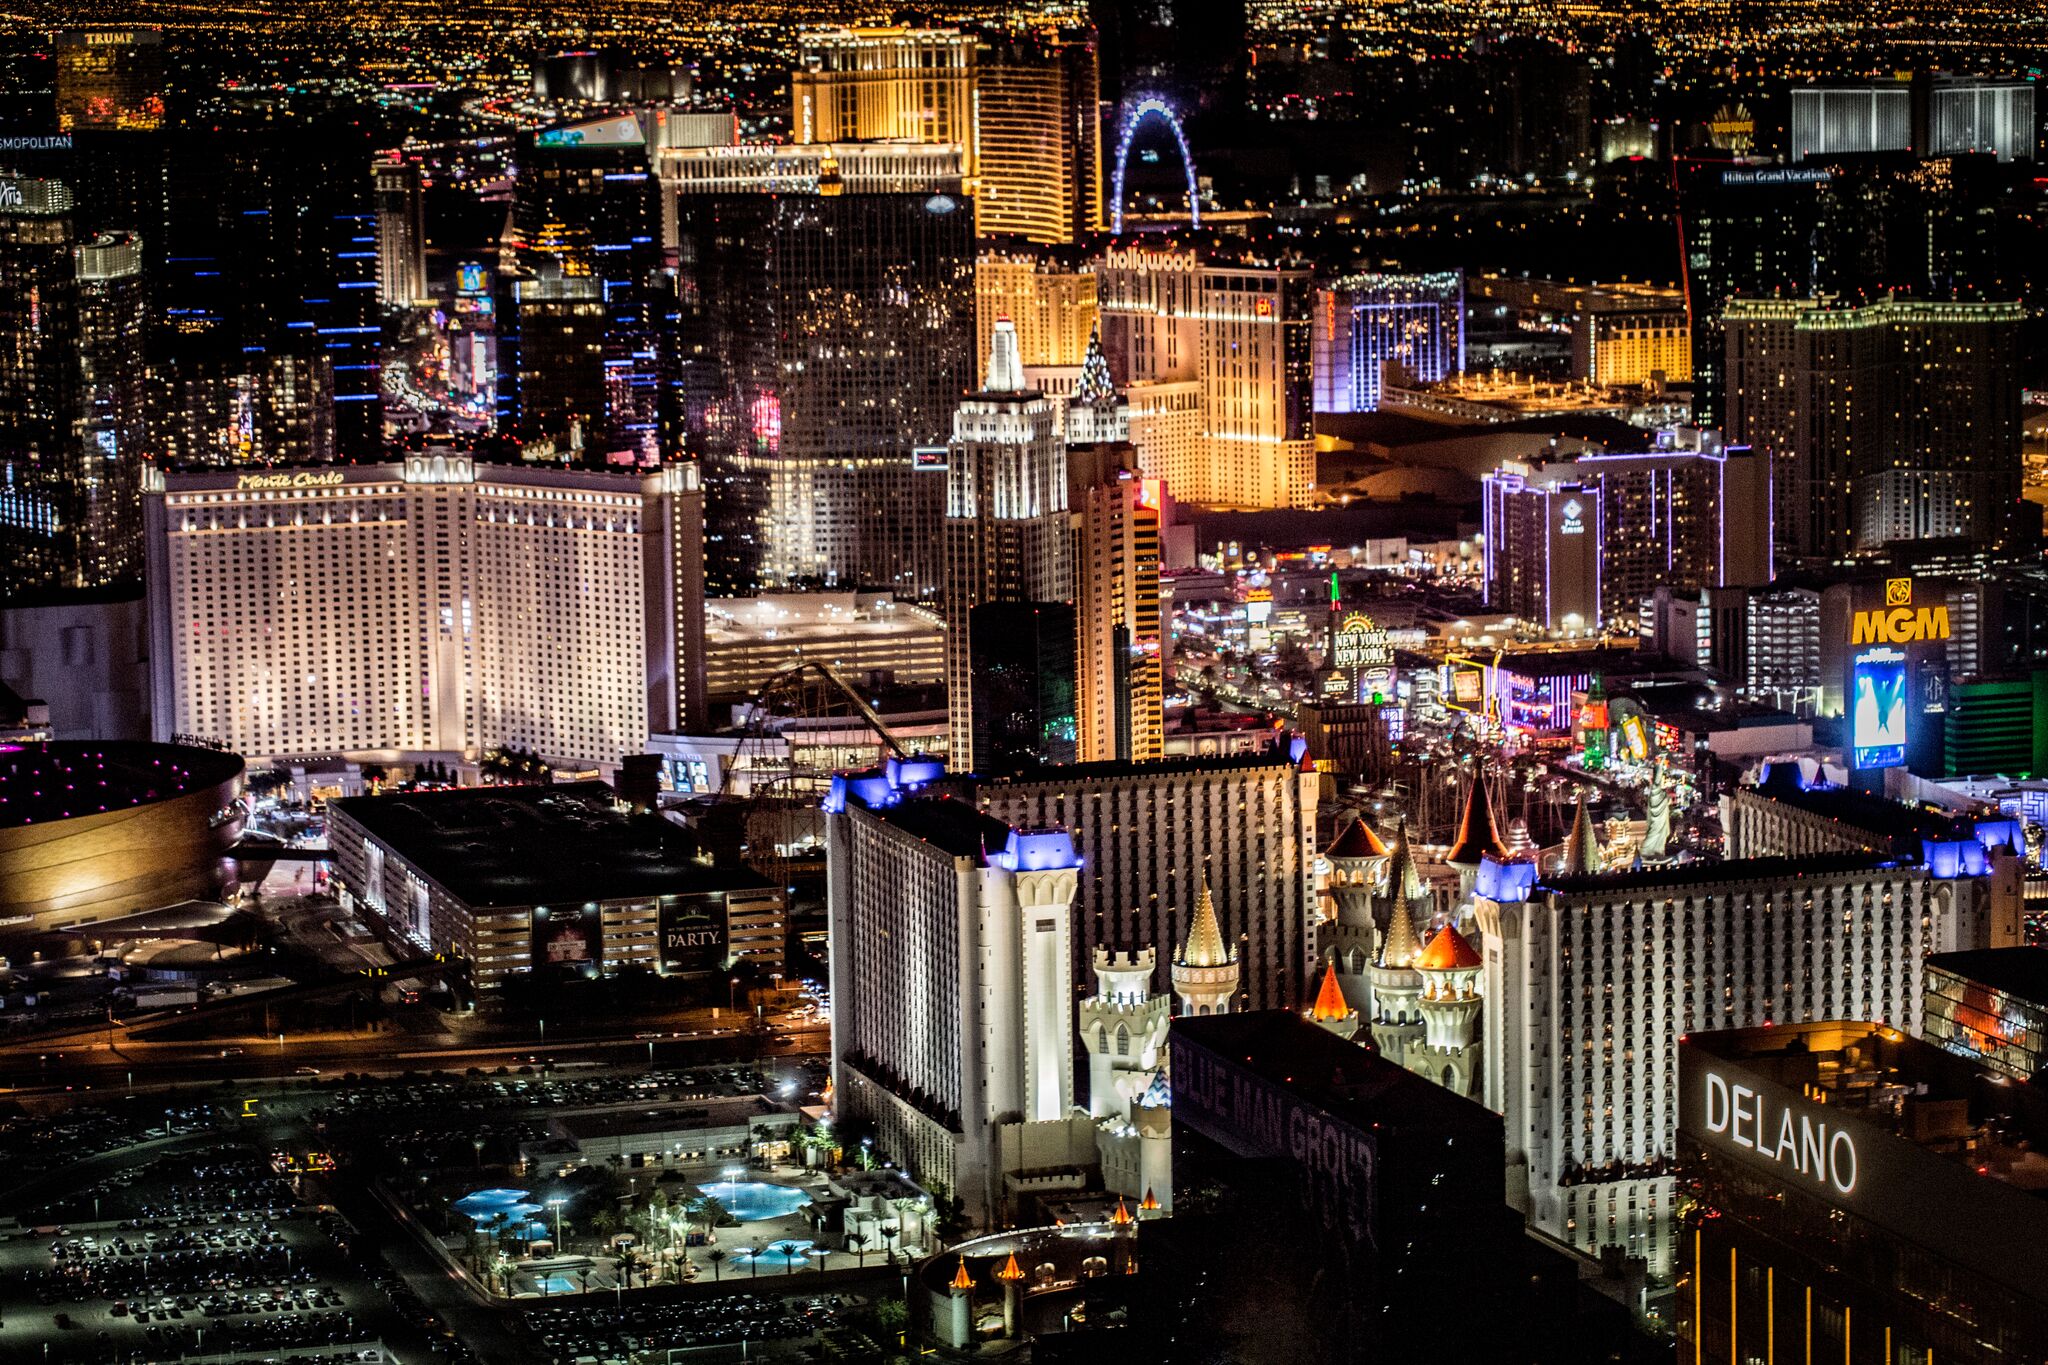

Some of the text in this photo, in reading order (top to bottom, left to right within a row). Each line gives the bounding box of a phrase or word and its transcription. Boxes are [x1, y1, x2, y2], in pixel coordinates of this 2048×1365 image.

[85, 32, 133, 44] TRUMP
[707, 145, 774, 157] VENETIAN
[1723, 168, 1831, 183] Hilton Grand Vacations
[0, 181, 22, 206] Aria
[1106, 246, 1196, 275] hollywood
[237, 470, 344, 490] Monte Carlo
[1852, 606, 1950, 645] MGM
[1335, 633, 1358, 648] NEW
[1360, 632, 1386, 645] YORK
[1335, 647, 1386, 662] NEW YORK
[667, 931, 721, 948] PARTY.
[1174, 1043, 1372, 1185] BLUE MAN GROUP
[1707, 1073, 1857, 1193] DELANO
